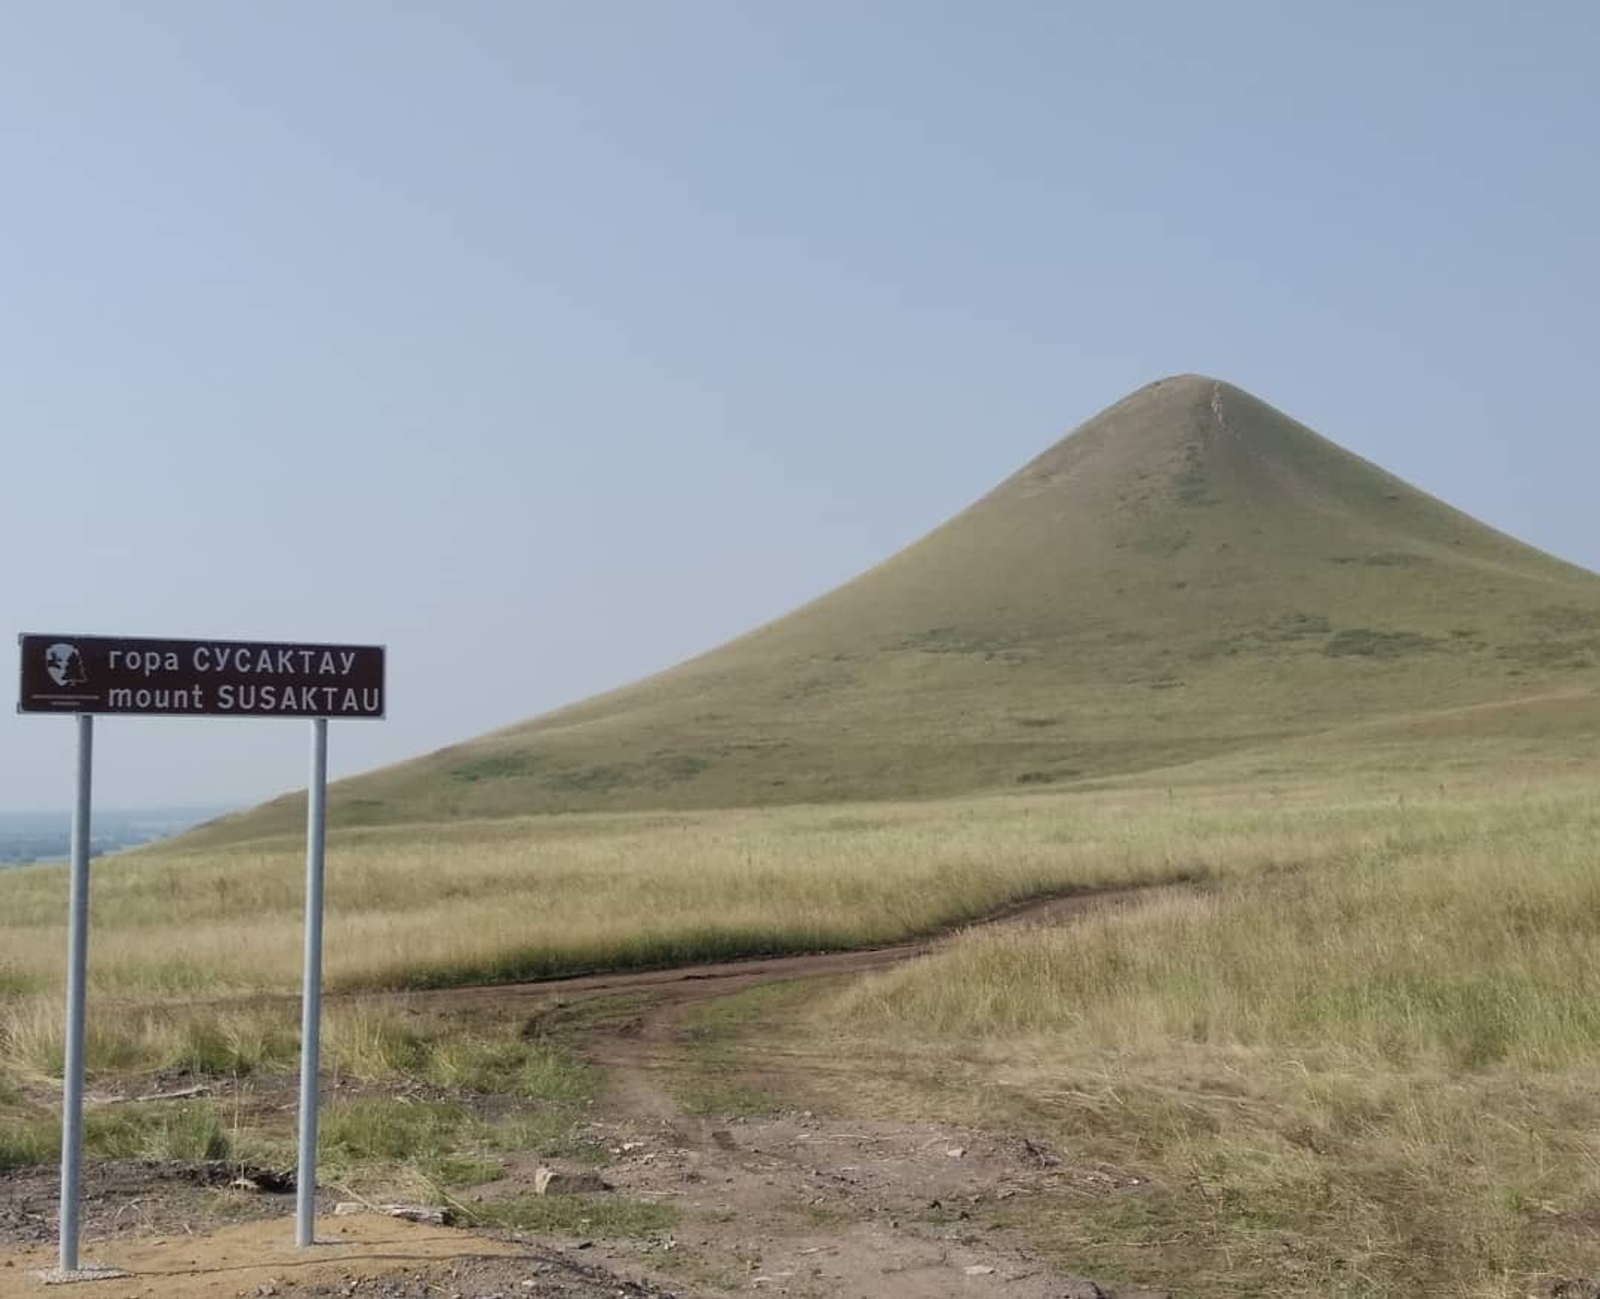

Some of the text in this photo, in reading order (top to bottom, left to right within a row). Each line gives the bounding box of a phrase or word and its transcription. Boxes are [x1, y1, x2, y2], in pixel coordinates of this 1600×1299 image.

[109, 647, 356, 677] гора СУСАКТАУ
[108, 684, 203, 709] mount
[218, 685, 379, 711] SUSAKTAU
